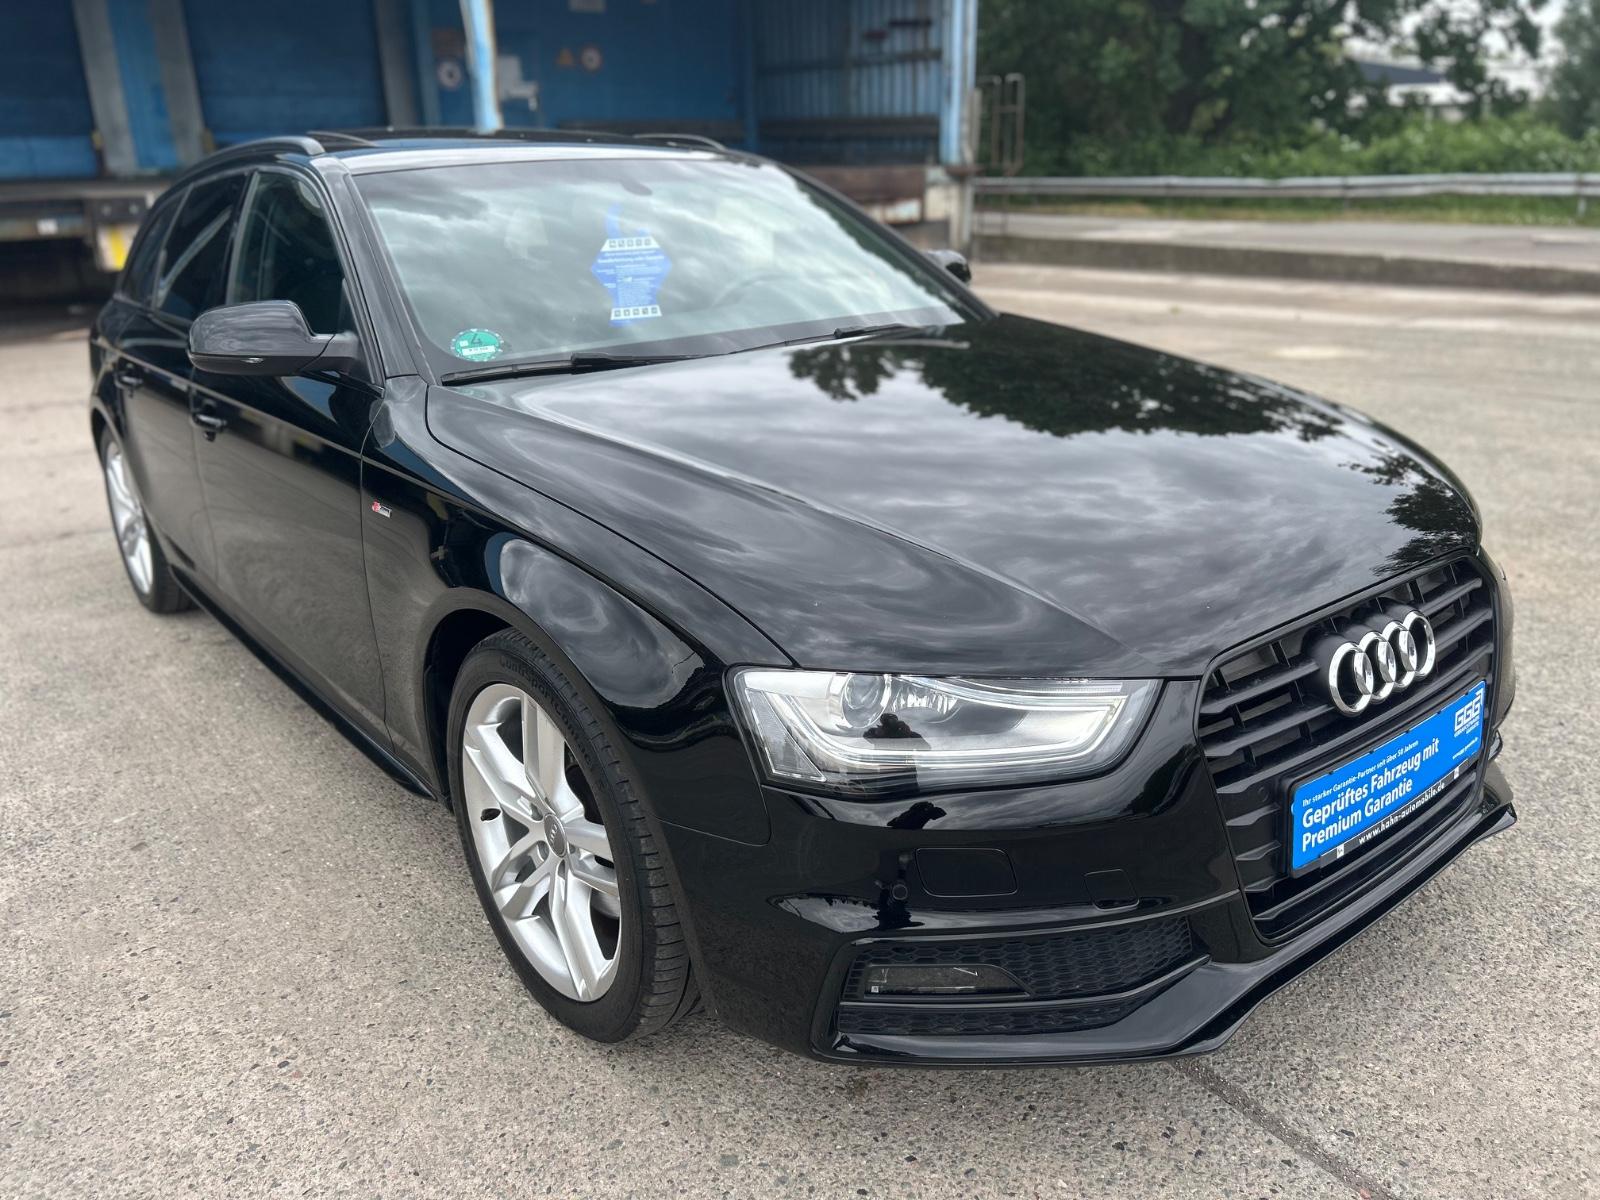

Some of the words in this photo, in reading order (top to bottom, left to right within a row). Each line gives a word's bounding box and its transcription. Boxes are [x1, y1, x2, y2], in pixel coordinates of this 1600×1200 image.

[1302, 784, 1369, 828] Geprüftes
[1370, 752, 1421, 794] Fahrzeug
[1422, 737, 1440, 762] mit
[1302, 809, 1362, 852] Premium
[1364, 777, 1413, 817] Garantie
[1358, 781, 1445, 844] www.hahn-automobile.de
